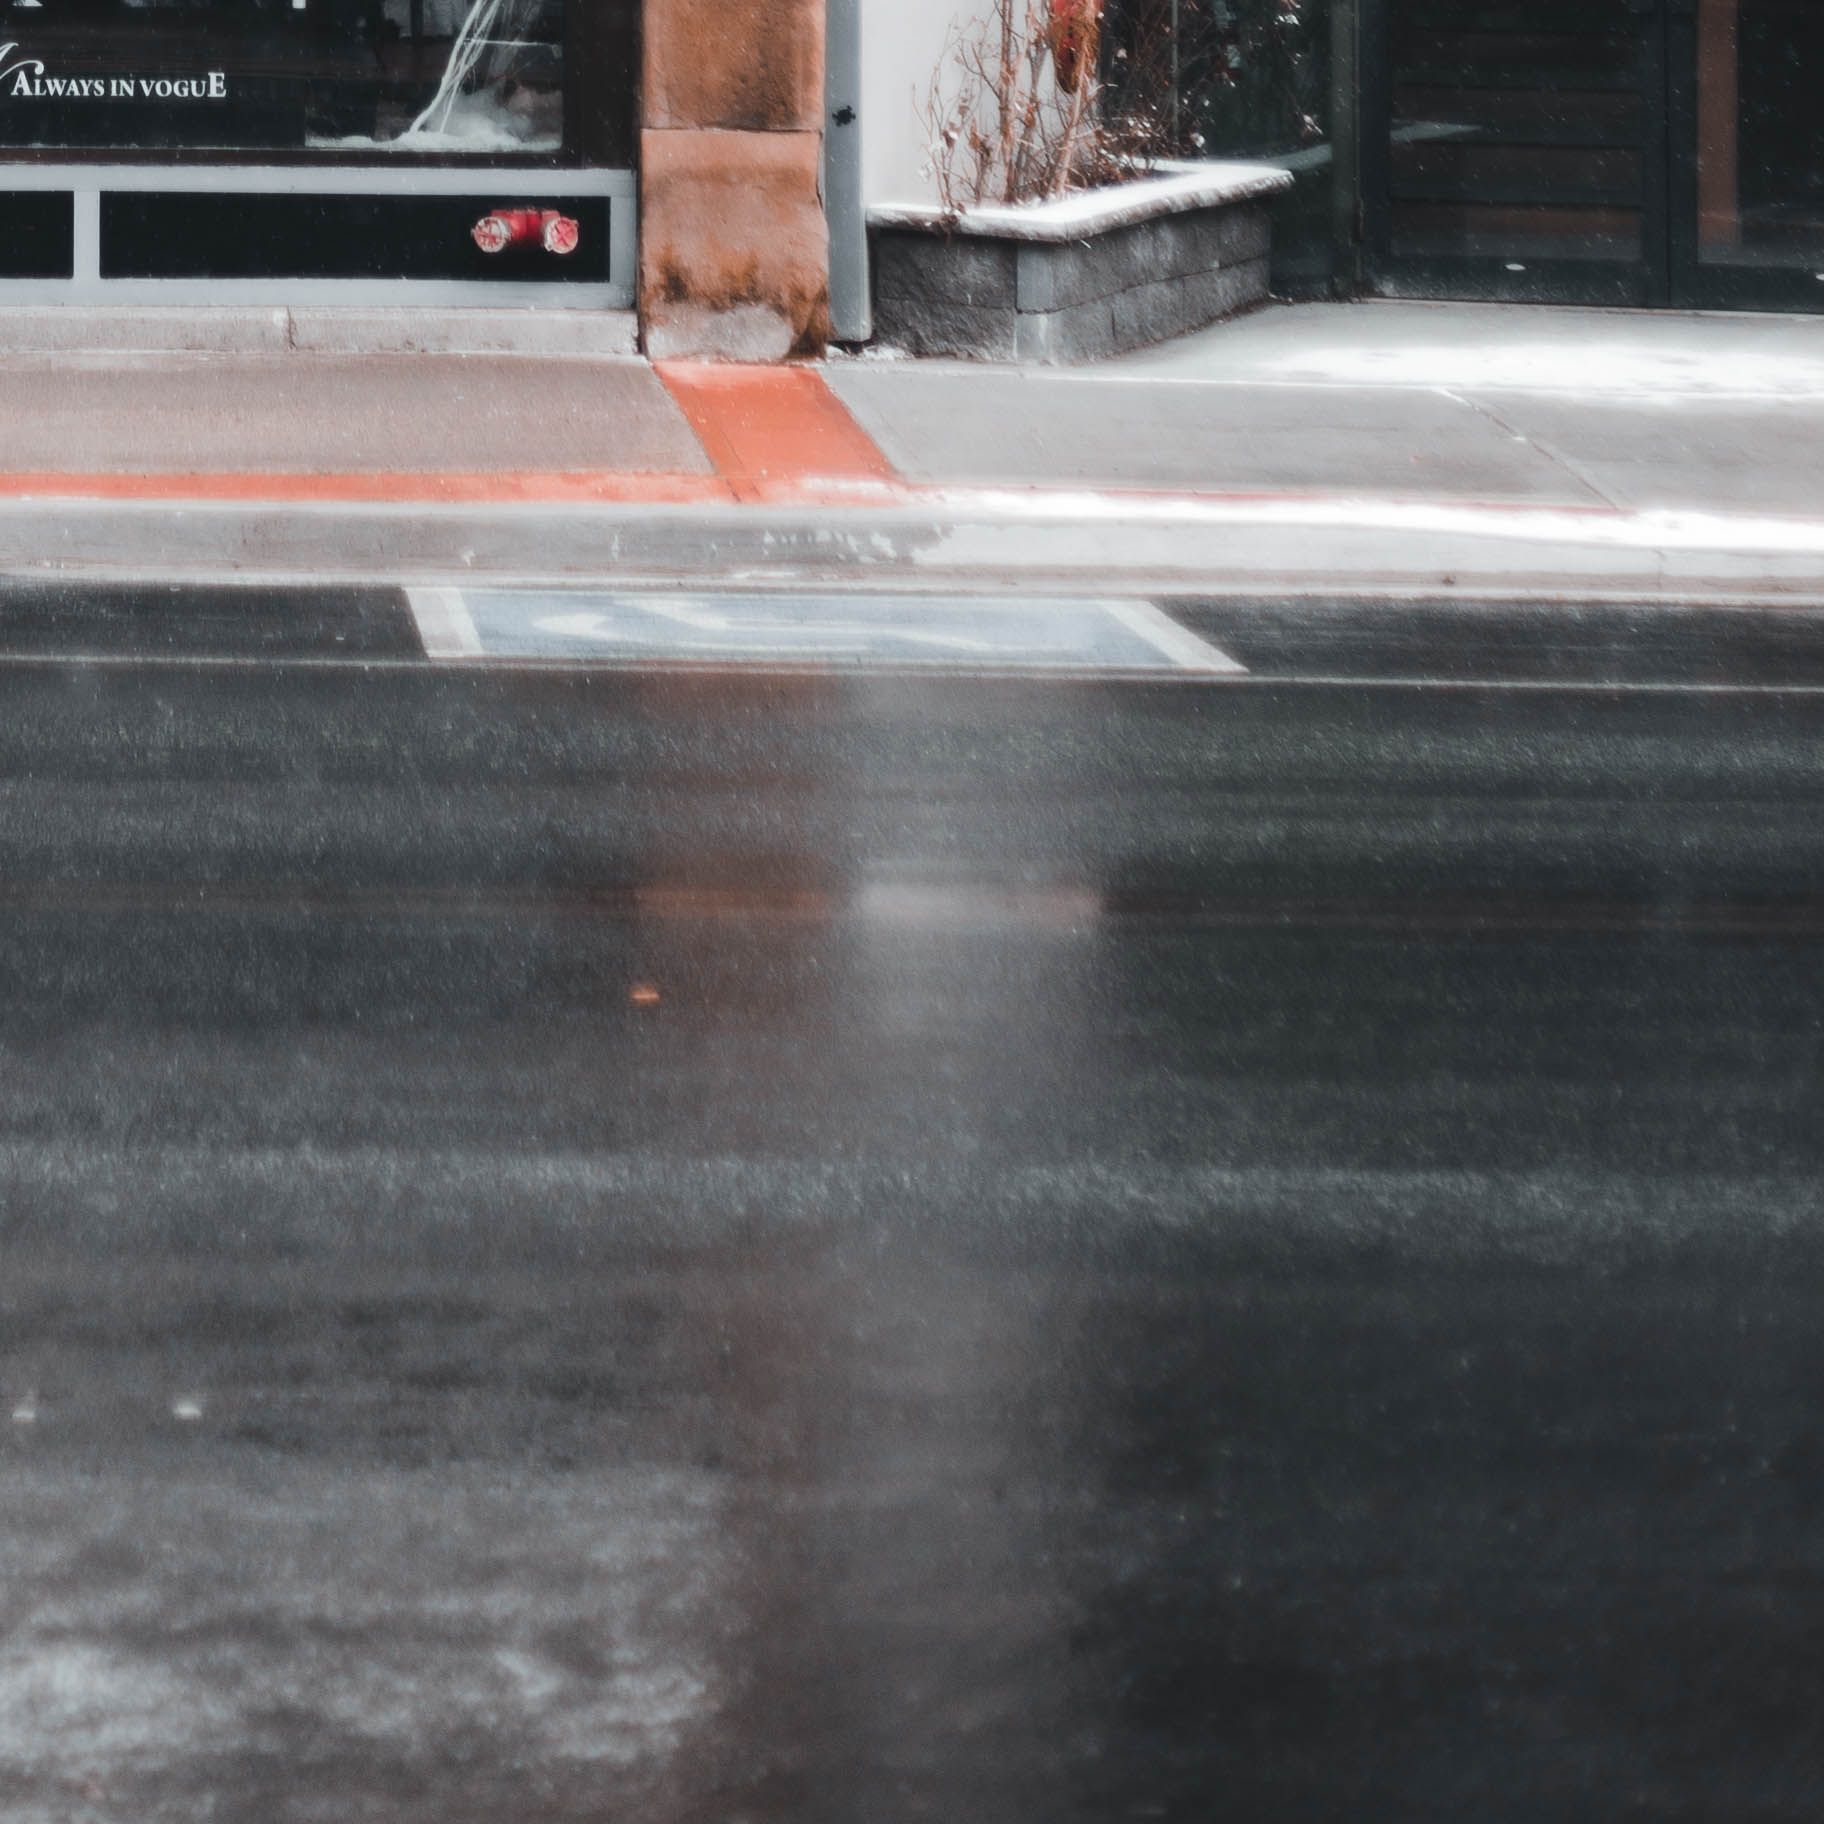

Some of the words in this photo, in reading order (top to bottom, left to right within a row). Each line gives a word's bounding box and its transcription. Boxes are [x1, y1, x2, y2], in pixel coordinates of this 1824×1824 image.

[10, 70, 105, 97] ALWAYS
[110, 78, 135, 97] IN
[139, 71, 227, 98] VOGUE
